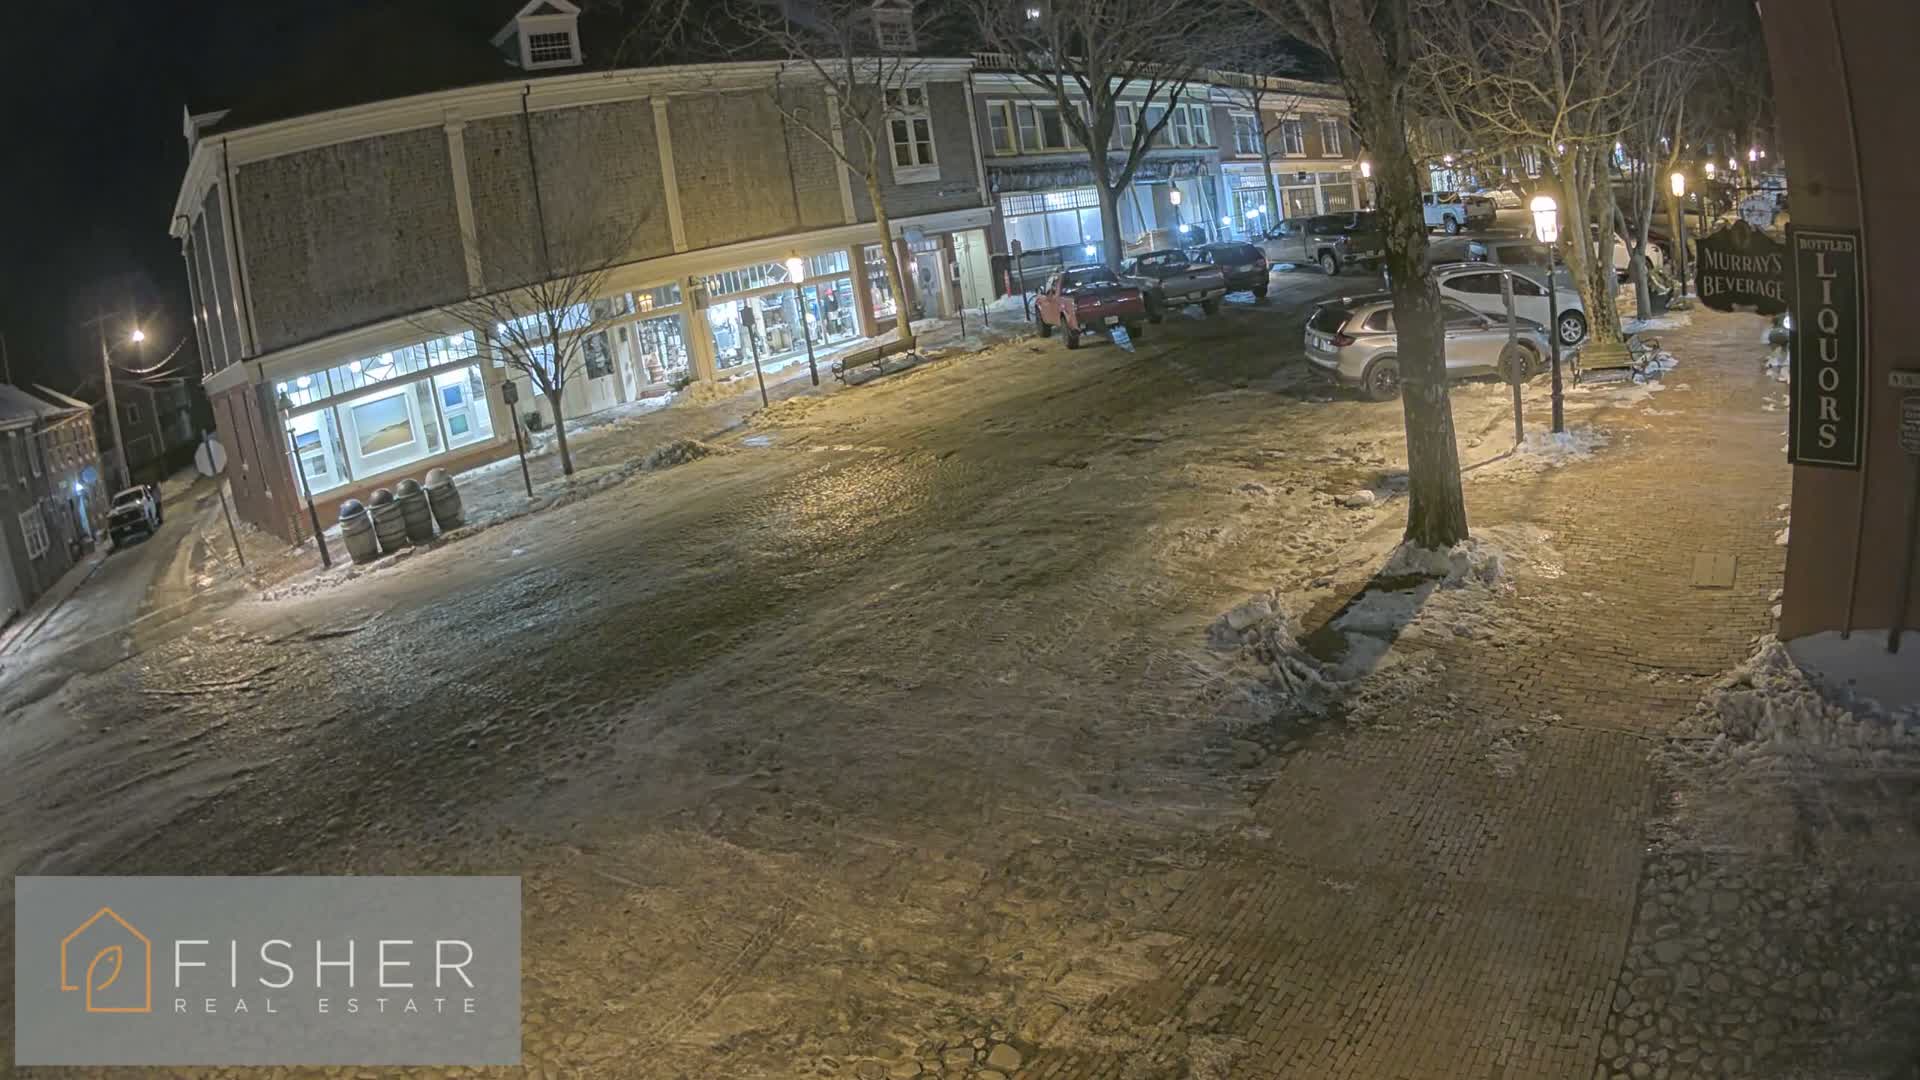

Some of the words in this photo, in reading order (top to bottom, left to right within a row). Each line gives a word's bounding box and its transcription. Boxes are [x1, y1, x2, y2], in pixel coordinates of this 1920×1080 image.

[1800, 239, 1853, 252] BOTTLED
[1704, 247, 1783, 274] MURRAY'S
[1703, 275, 1785, 303] BEVERAGE
[1815, 252, 1841, 449] LIQUORS
